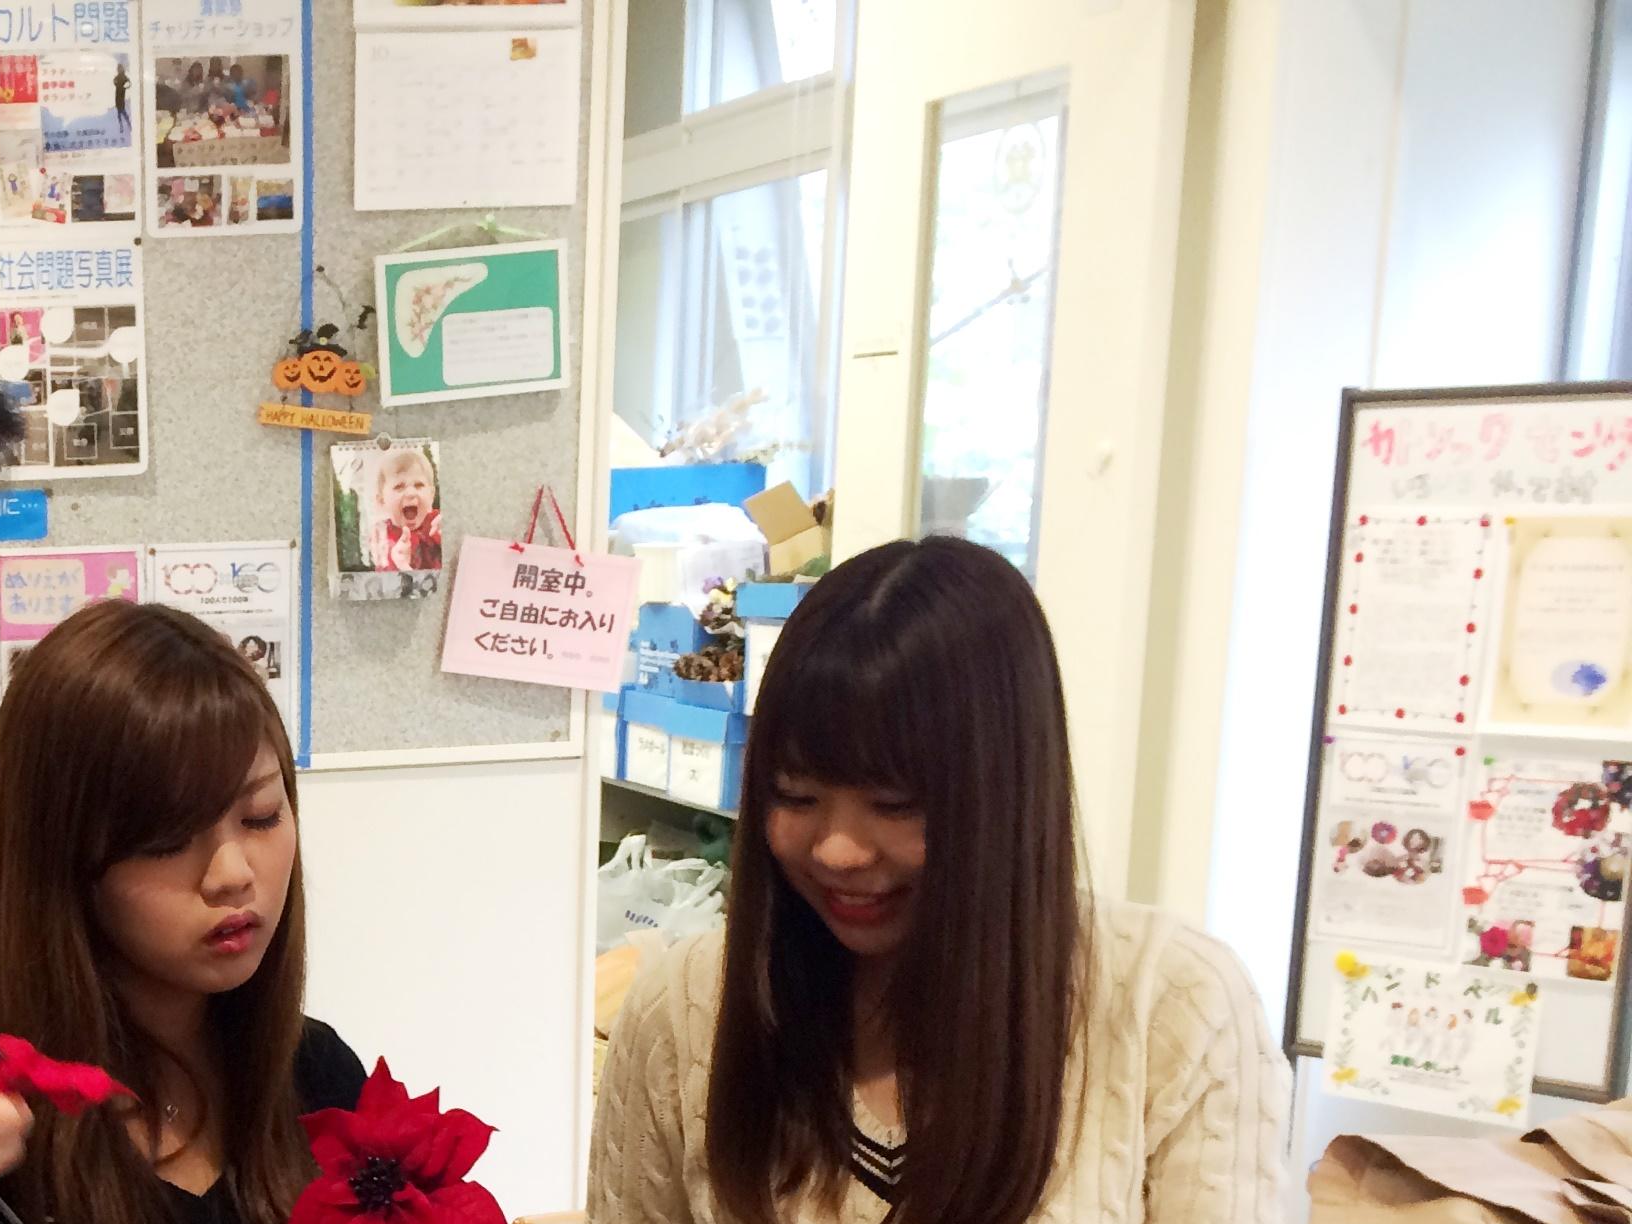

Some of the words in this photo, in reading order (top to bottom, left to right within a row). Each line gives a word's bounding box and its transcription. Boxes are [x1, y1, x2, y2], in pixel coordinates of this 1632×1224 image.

[266, 410, 296, 424] HAPPY
[300, 413, 364, 429] HALLOWEEN
[513, 563, 593, 598] 開室中。
[480, 598, 615, 633] ご自由にお入り
[474, 631, 554, 660] ください。
